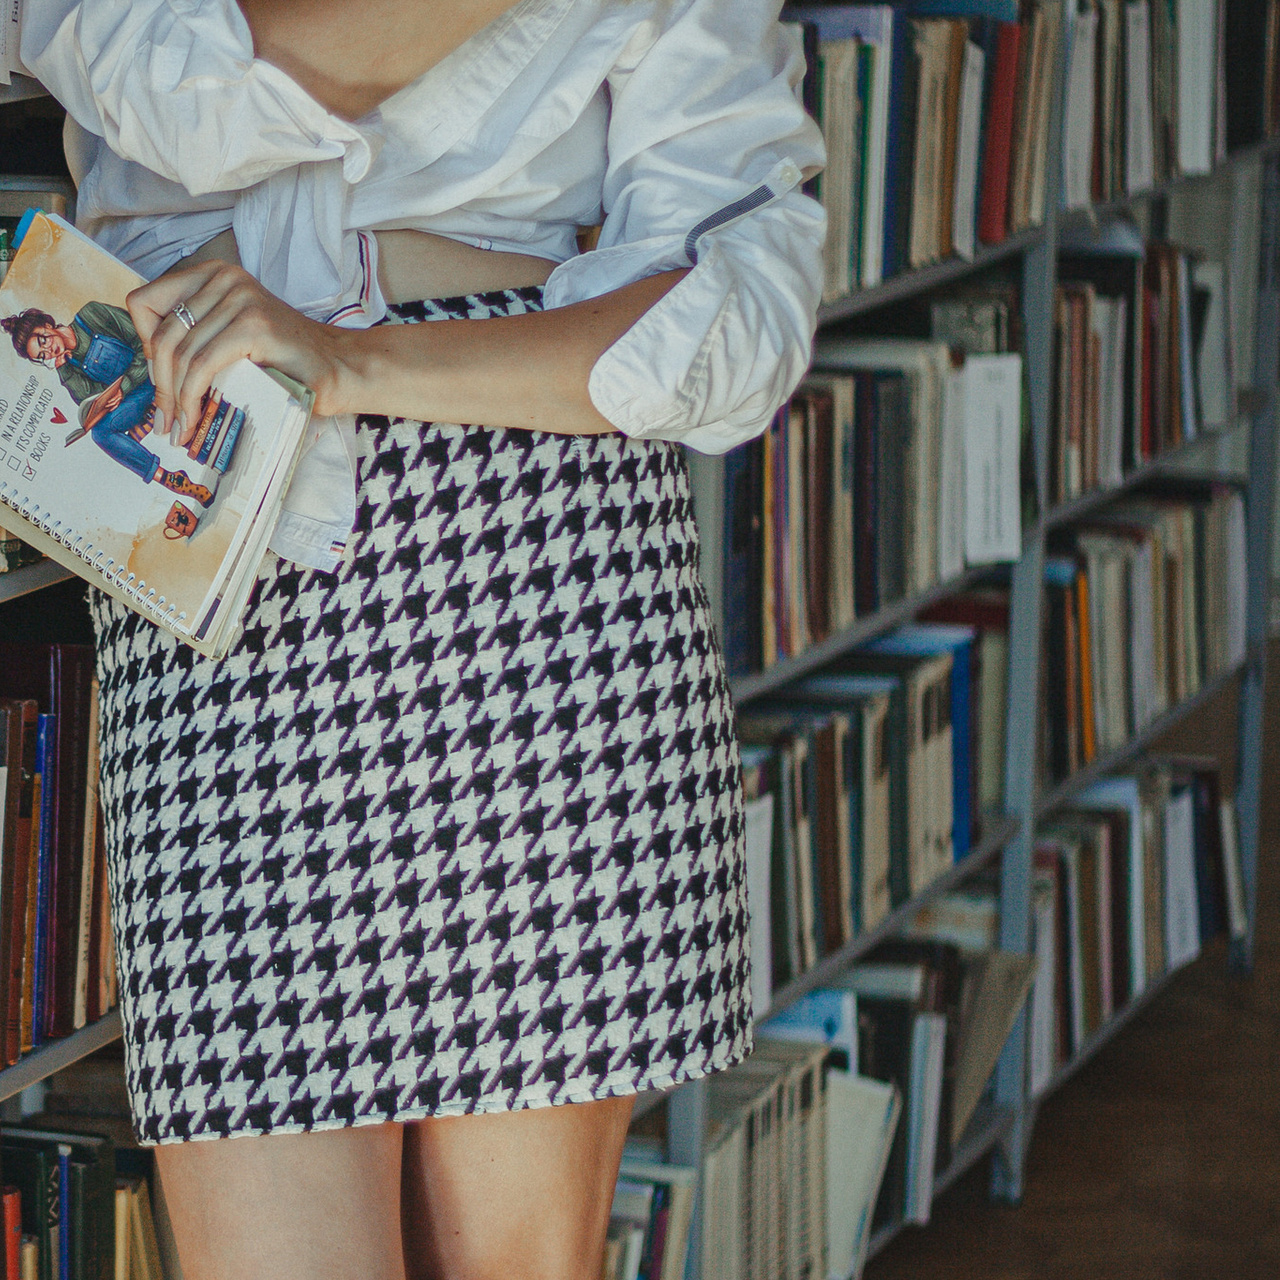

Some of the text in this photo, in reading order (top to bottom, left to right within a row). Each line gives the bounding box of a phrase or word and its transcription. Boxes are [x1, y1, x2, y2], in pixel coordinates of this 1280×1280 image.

[1, 429, 14, 443] IN
[8, 374, 40, 426] RELATIONSHIP
[15, 387, 54, 453] IT'S COMPLICATED
[29, 431, 52, 463] BOOKS
